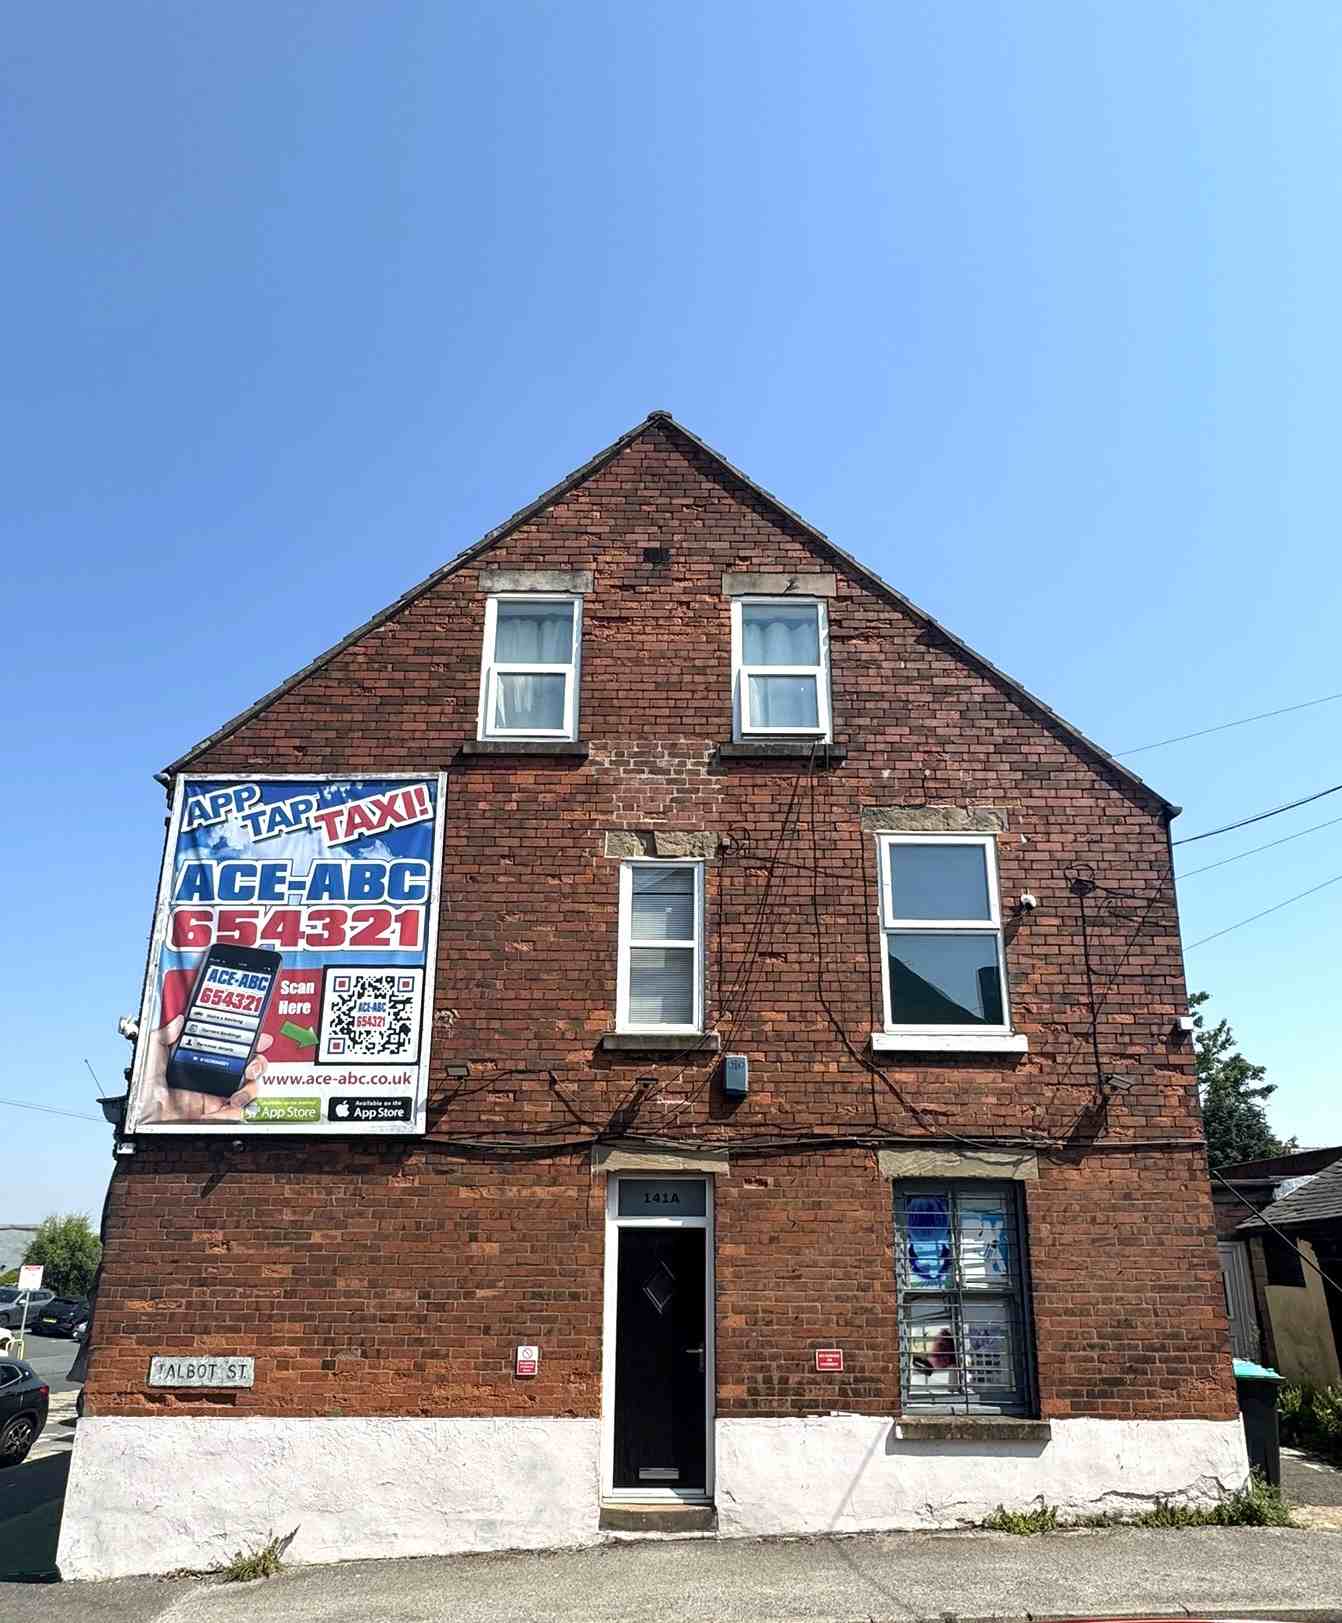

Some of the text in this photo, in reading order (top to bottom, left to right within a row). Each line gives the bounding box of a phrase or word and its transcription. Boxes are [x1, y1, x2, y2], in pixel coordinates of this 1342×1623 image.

[186, 785, 430, 842] APP TAP TAXI!
[174, 862, 428, 901] ACE-ABC
[170, 908, 419, 948] 654321
[206, 968, 270, 992] ACE-ABC
[280, 979, 315, 995] Scan
[199, 987, 263, 1013] 654321
[278, 1000, 312, 1015] Here
[262, 1071, 413, 1086] www.ace-abc.co.uk
[262, 1106, 317, 1120] App Store
[353, 1106, 405, 1120] App Store
[644, 1192, 681, 1204] 141A
[226, 1363, 248, 1380] ST.
